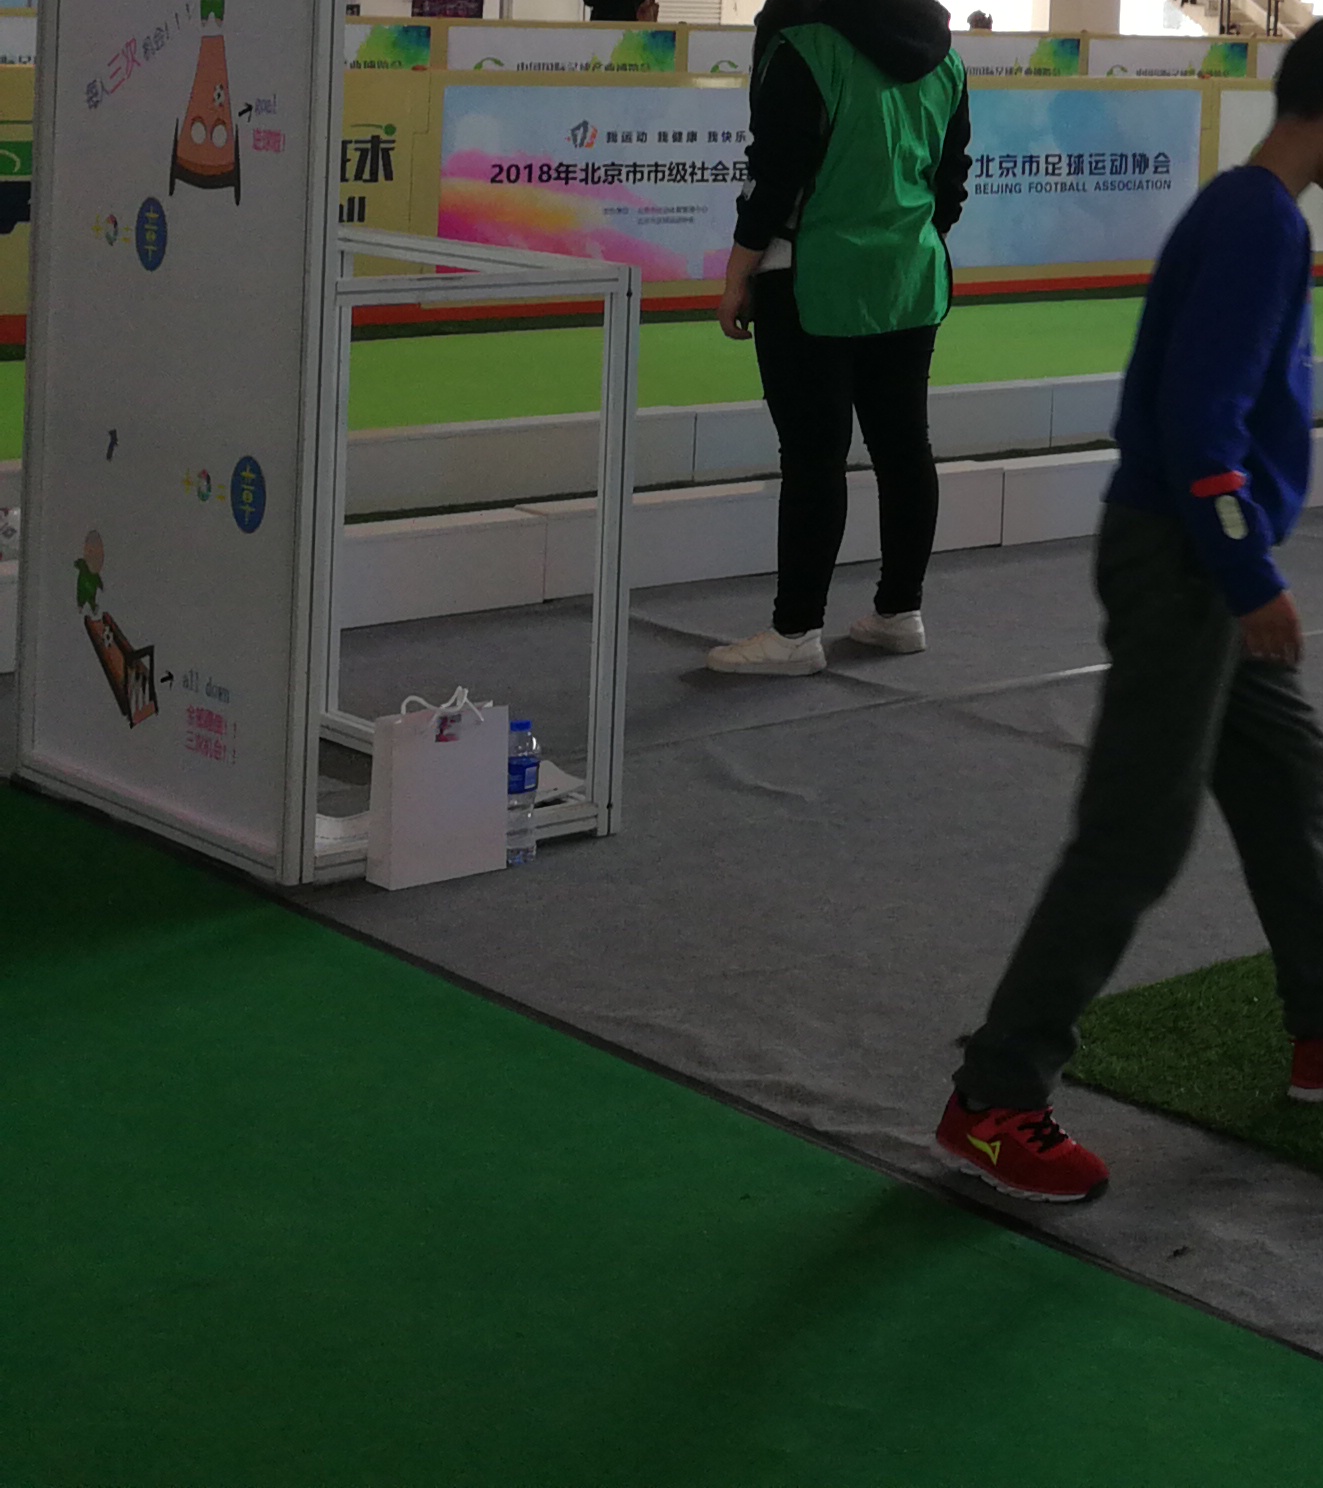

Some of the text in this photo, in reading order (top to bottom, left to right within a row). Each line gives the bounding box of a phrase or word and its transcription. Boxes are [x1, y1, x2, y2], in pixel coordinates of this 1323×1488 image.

[606, 129, 648, 144] 我运动
[657, 129, 698, 144] 我健康
[974, 152, 1172, 179] 北京市足球运动协会
[974, 179, 1172, 195] BEIJING FOOTBALL ASSOCIATION
